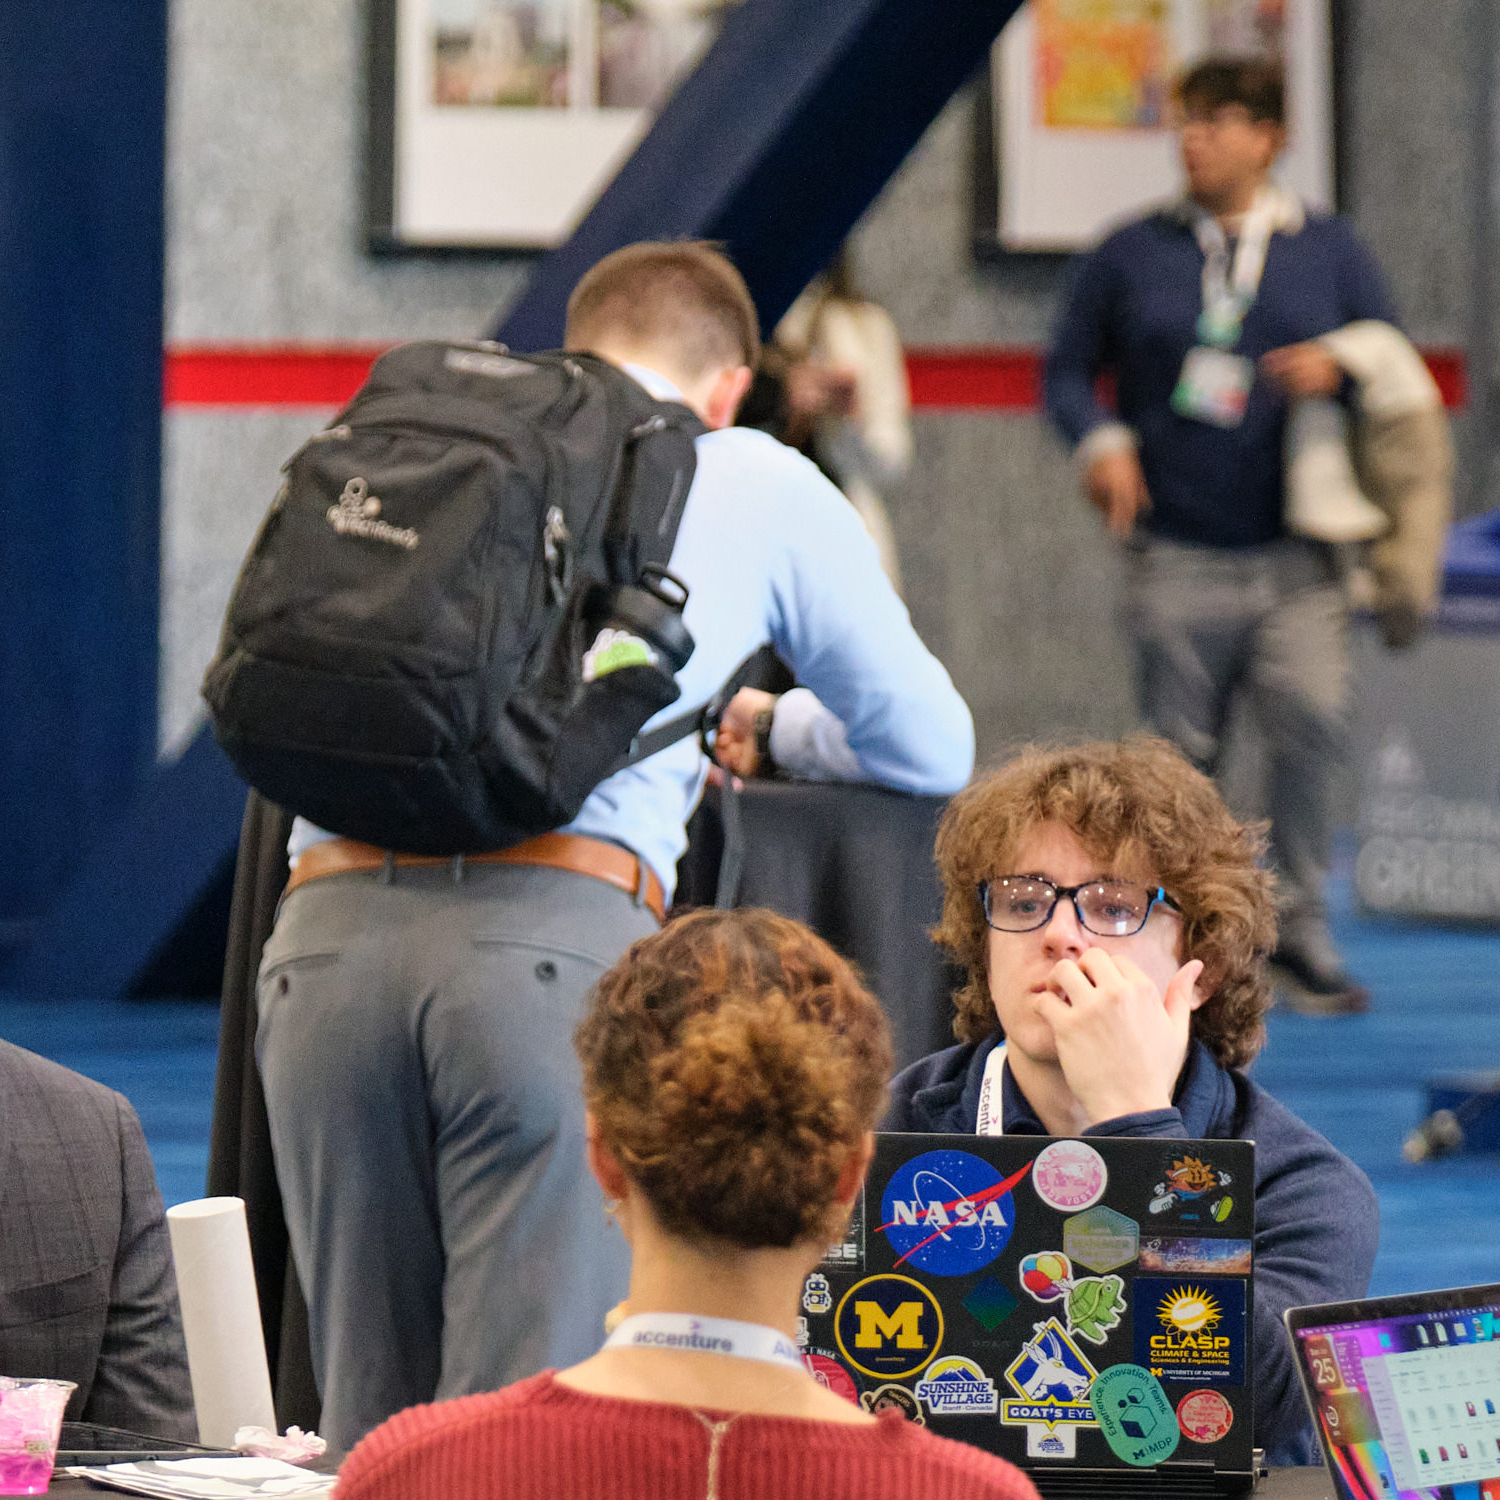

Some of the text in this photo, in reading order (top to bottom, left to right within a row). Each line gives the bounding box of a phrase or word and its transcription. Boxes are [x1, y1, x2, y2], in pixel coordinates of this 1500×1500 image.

[892, 1200, 1008, 1227] NASA
[855, 1301, 924, 1349] M
[632, 1330, 734, 1353] accenture
[1149, 1335, 1231, 1350] CLASP
[1150, 1350, 1230, 1359] CLIMATE & SPACE
[1313, 1357, 1336, 1384] 25
[918, 1382, 989, 1398] SUNSHINE
[929, 1394, 994, 1408] VILLAGE
[1010, 1407, 1093, 1419] GOAT'S EYE
